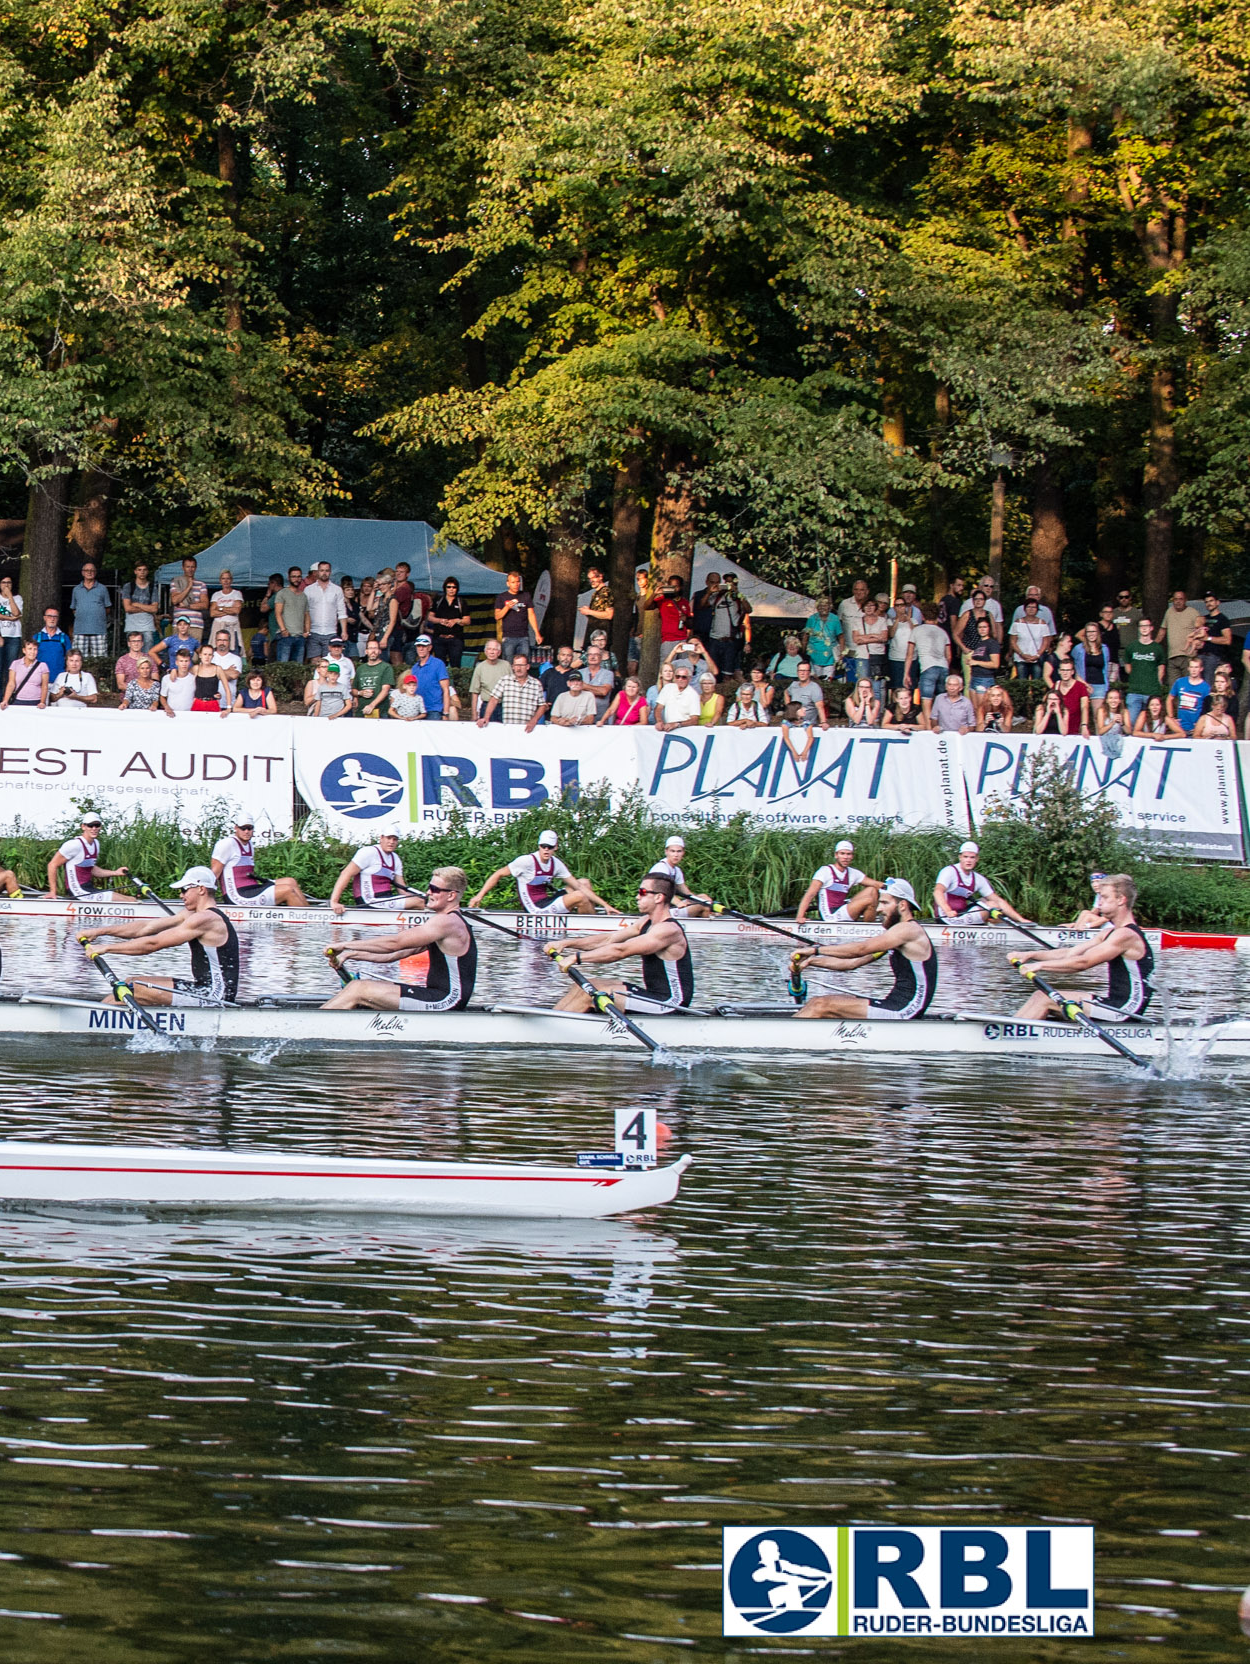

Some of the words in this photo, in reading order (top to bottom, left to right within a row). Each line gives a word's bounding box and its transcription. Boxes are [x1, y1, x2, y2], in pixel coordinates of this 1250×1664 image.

[119, 751, 284, 783] AUDIT
[648, 733, 910, 804] PLANAT
[421, 754, 611, 811] RBL
[937, 740, 955, 826] www.planat.de
[1214, 749, 1230, 824] www.planat.de
[757, 812, 828, 824] software
[1137, 810, 1187, 823] service
[66, 902, 135, 916] 4row.com
[249, 911, 264, 920] für
[266, 911, 284, 920] den
[288, 911, 344, 922] Rudersport
[516, 914, 568, 929] BERLIN
[798, 924, 812, 934] für
[815, 925, 832, 935] den
[941, 927, 1007, 941] 4row.com
[1069, 931, 1090, 940] RBL
[365, 1012, 405, 1031] Melitta
[829, 1020, 869, 1039] Melitta
[1002, 1023, 1039, 1037] RBL
[621, 1111, 647, 1150] 4
[636, 1154, 657, 1162] RBL
